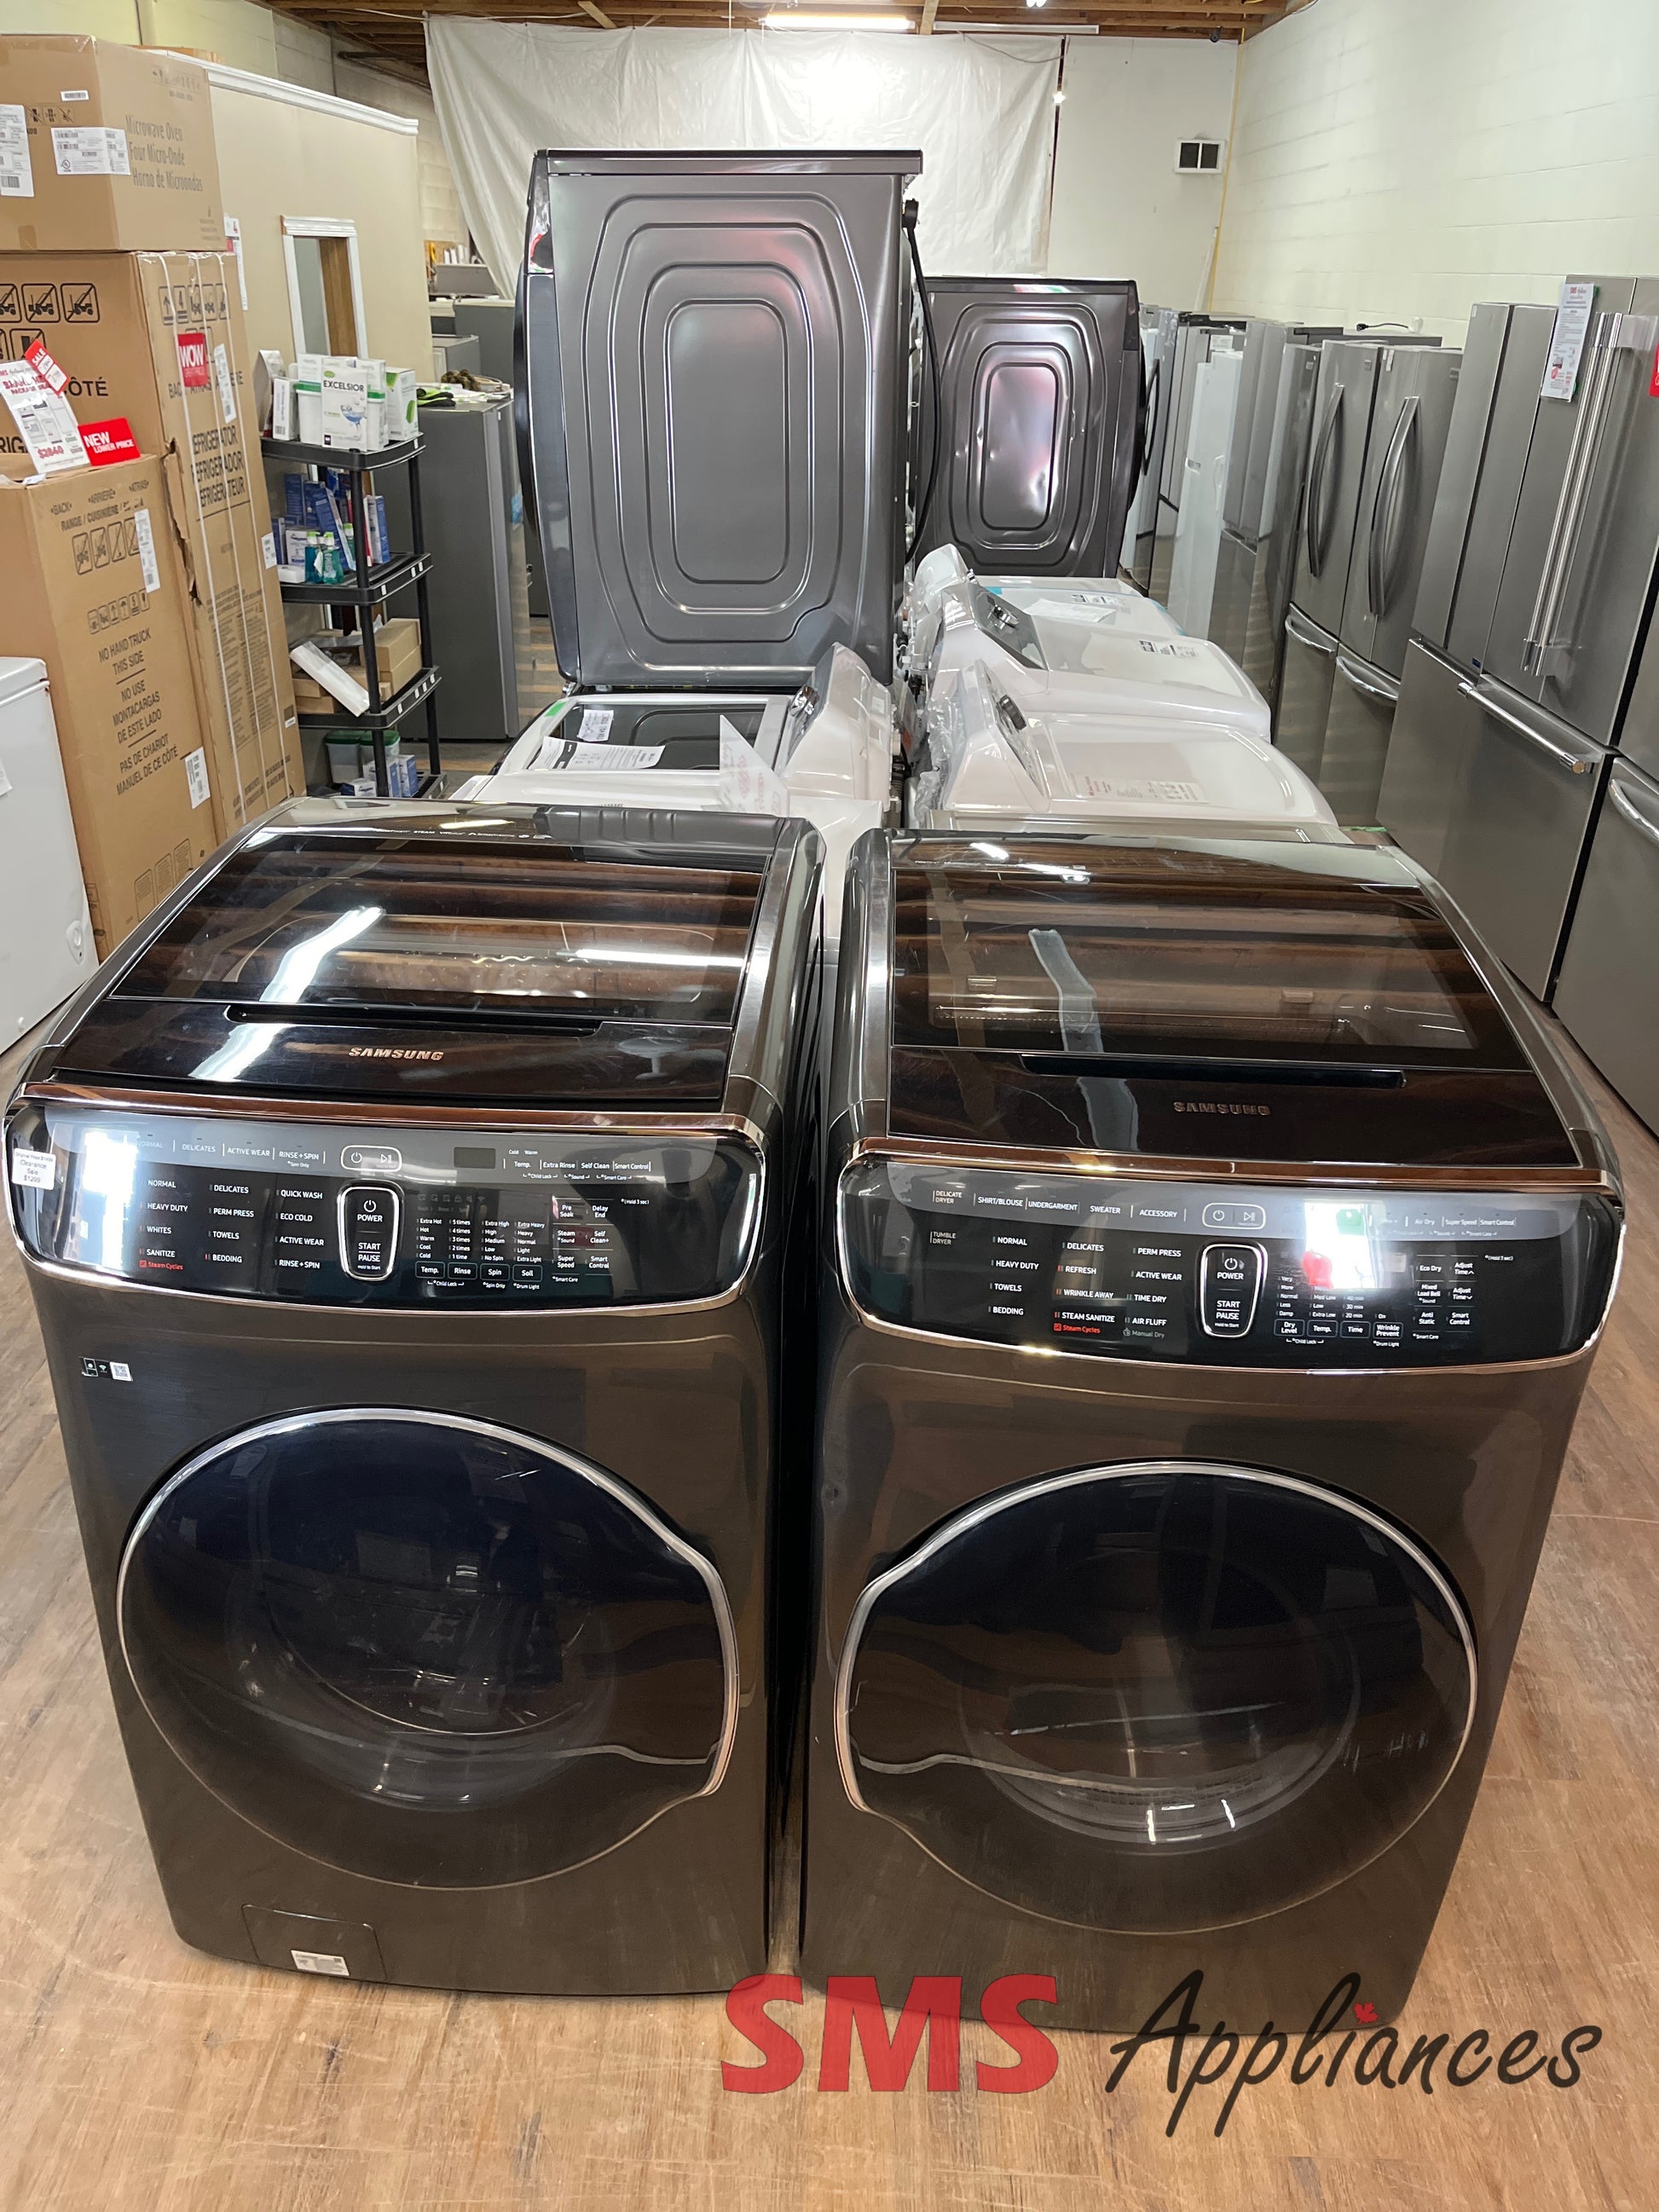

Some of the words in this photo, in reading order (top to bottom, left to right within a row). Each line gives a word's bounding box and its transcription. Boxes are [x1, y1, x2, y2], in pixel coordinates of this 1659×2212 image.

[125, 116, 164, 136] Microwave
[166, 122, 182, 141] Oven
[129, 141, 146, 161] Four
[147, 144, 185, 165] Micro-Onde
[133, 170, 154, 188] Horno
[157, 173, 165, 188] de
[166, 173, 203, 191] Microondas
[32, 348, 46, 366] SALE
[180, 344, 204, 367] WOW
[66, 377, 108, 396] ÔTÉ
[323, 380, 364, 392] EXCELSIOR
[84, 431, 110, 447] NEW
[93, 443, 116, 453] LOWER
[116, 440, 134, 449] PRICE
[61, 516, 82, 531] RANGE
[99, 646, 109, 662] NO
[110, 638, 128, 656] HAND
[129, 628, 151, 650] TRUCK
[113, 658, 128, 675] THIS
[130, 650, 144, 667] SIDE
[122, 688, 131, 702] NO
[133, 679, 146, 696] USE
[113, 691, 160, 726] MONTACARGAS
[118, 731, 127, 743] DE
[128, 719, 144, 737] ESTE
[145, 709, 161, 728] LADO
[120, 759, 133, 774] PAS
[134, 750, 142, 763] DE
[143, 733, 169, 758] CHARIOT
[117, 771, 143, 795] MANUEL
[143, 764, 153, 777] DE
[153, 756, 162, 771] CE
[163, 746, 178, 765] CÔTÉ
[349, 1048, 443, 1061] SAMSUNG
[1173, 1101, 1270, 1116] SAMSUNG
[182, 1143, 216, 1152] DELICATES
[279, 1151, 298, 1159] RINSE
[20, 1159, 47, 1169] Clearance
[147, 1180, 176, 1188] NORMAL
[214, 1185, 249, 1193] DELICATES
[978, 1197, 1023, 1206] SHIRT/BLOUSE
[1028, 1201, 1078, 1210] UNDERGARMENT
[213, 1208, 232, 1216] PERM
[1090, 1205, 1121, 1215] SWEATER
[1139, 1209, 1177, 1219] ACCESSORY
[357, 1214, 383, 1222] POWER
[147, 1226, 171, 1234] WHITES
[213, 1231, 240, 1239] TOWELS
[280, 1236, 303, 1245] ACTIVE
[303, 1238, 324, 1246] WEAR
[997, 1237, 1027, 1246] NORMAL
[1067, 1242, 1104, 1252] DELICATES
[147, 1249, 176, 1258] SANITIZE
[1159, 1249, 1182, 1257] PRESS
[212, 1255, 242, 1263] BEDDING
[304, 1261, 320, 1269] SPIN
[996, 1260, 1019, 1268] HEAVY
[1020, 1262, 1039, 1270] DUTY
[1066, 1266, 1097, 1274] REFRESH
[1136, 1271, 1162, 1279] ACTIVE
[1163, 1273, 1182, 1281] WEAR
[995, 1283, 1022, 1291] TOWELS
[1064, 1289, 1095, 1297] WRINKLE
[1095, 1291, 1113, 1299] AWAY
[1152, 1295, 1167, 1303] DRY
[992, 1306, 1024, 1315] BEDDING
[1062, 1312, 1085, 1320] STEAM
[1085, 1314, 1115, 1323] SANITIZE
[1216, 1312, 1239, 1320] PAUSE
[1132, 1317, 1144, 1325] AIR
[1145, 1318, 1167, 1326] FLUFF
[1082, 1325, 1101, 1334] Cycles
[1153, 1331, 1165, 1339] Dry
